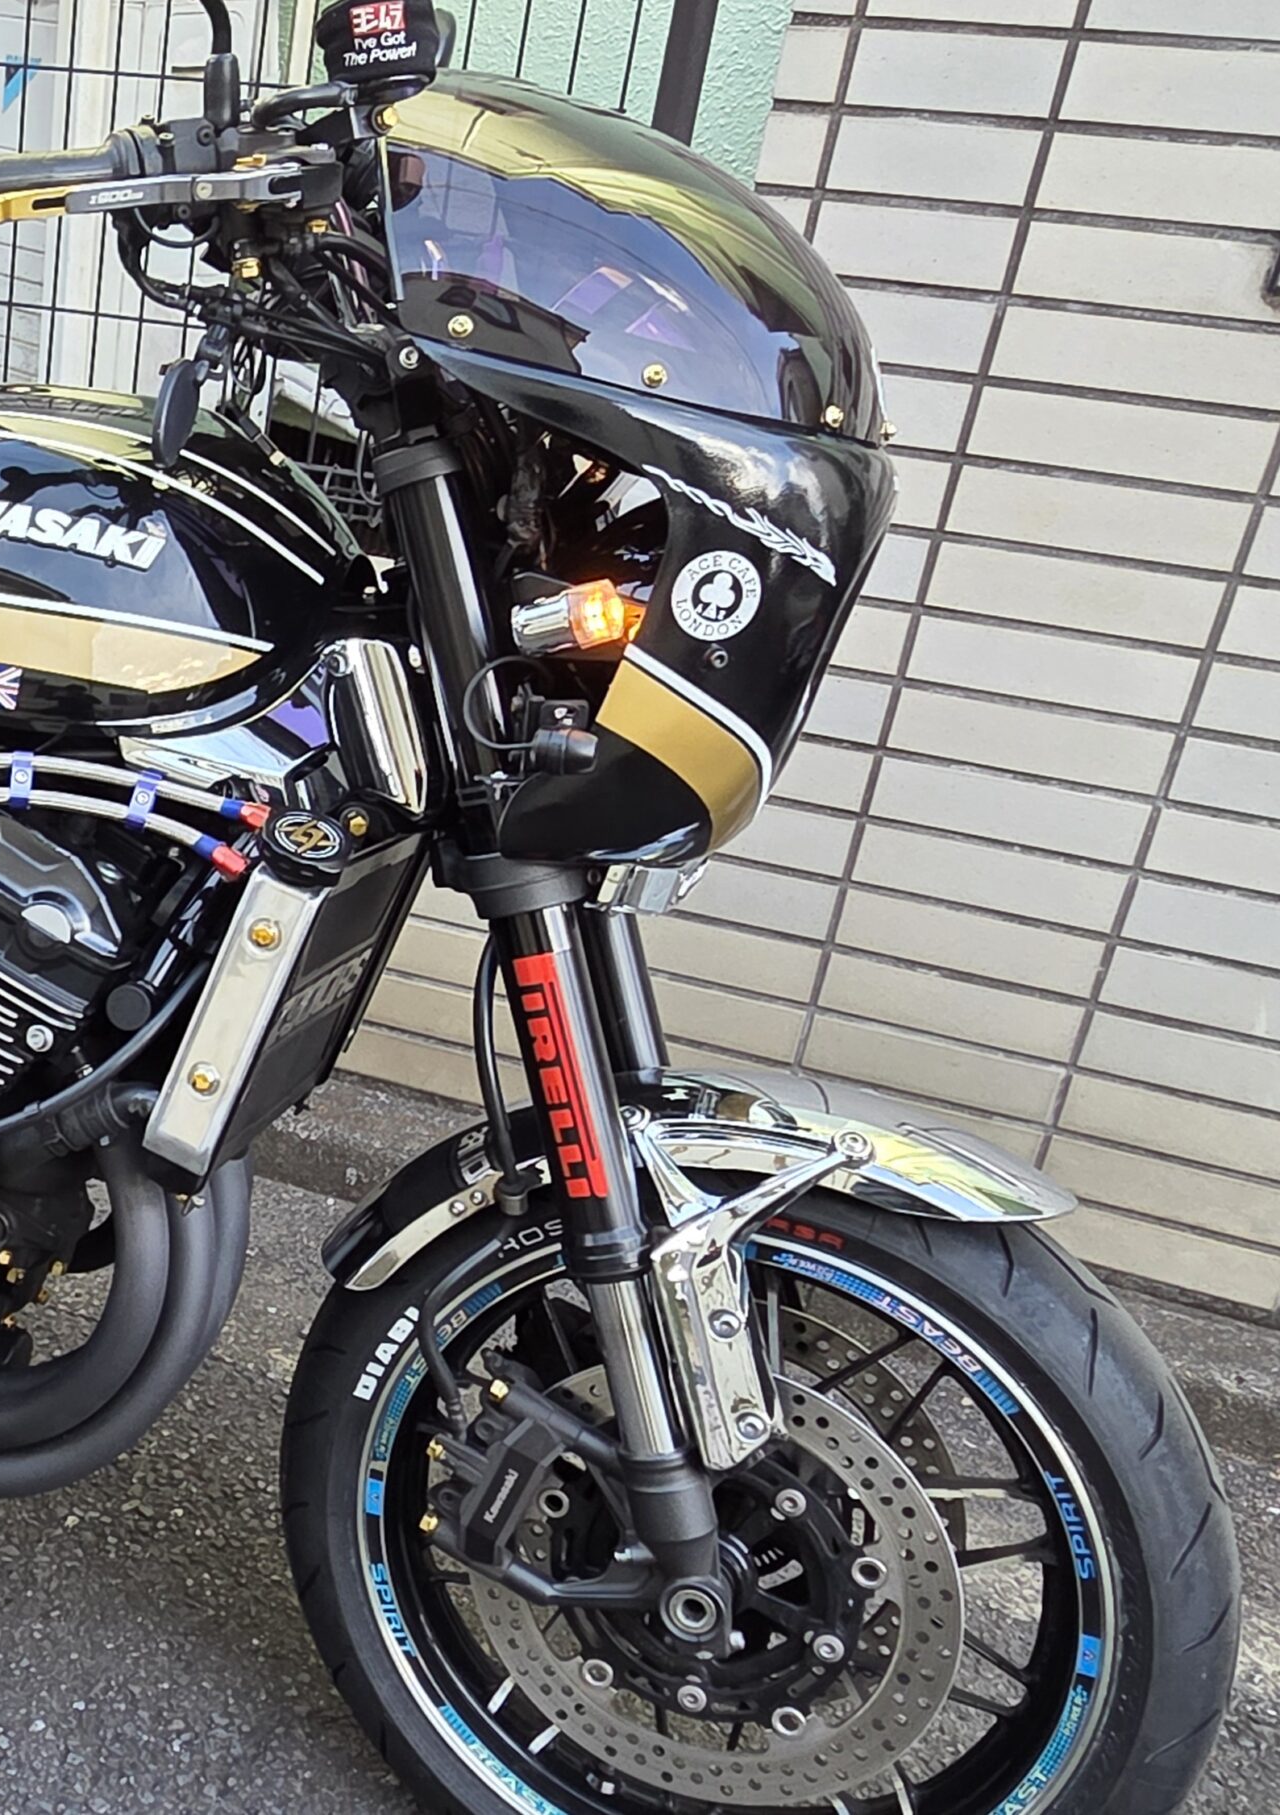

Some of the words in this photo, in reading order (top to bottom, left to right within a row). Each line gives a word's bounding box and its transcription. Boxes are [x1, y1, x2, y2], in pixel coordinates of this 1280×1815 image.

[343, 52, 366, 67] The
[354, 38, 377, 50] I've
[380, 31, 406, 46] Got
[687, 555, 722, 580] ACE
[729, 557, 756, 598] CAFE
[676, 598, 742, 636] LONDON
[513, 953, 609, 1198] PIRELLI
[875, 1294, 984, 1373] BEAST
[1045, 1471, 1097, 1580] SPIRIT
[370, 1562, 417, 1658] SPIRIT
